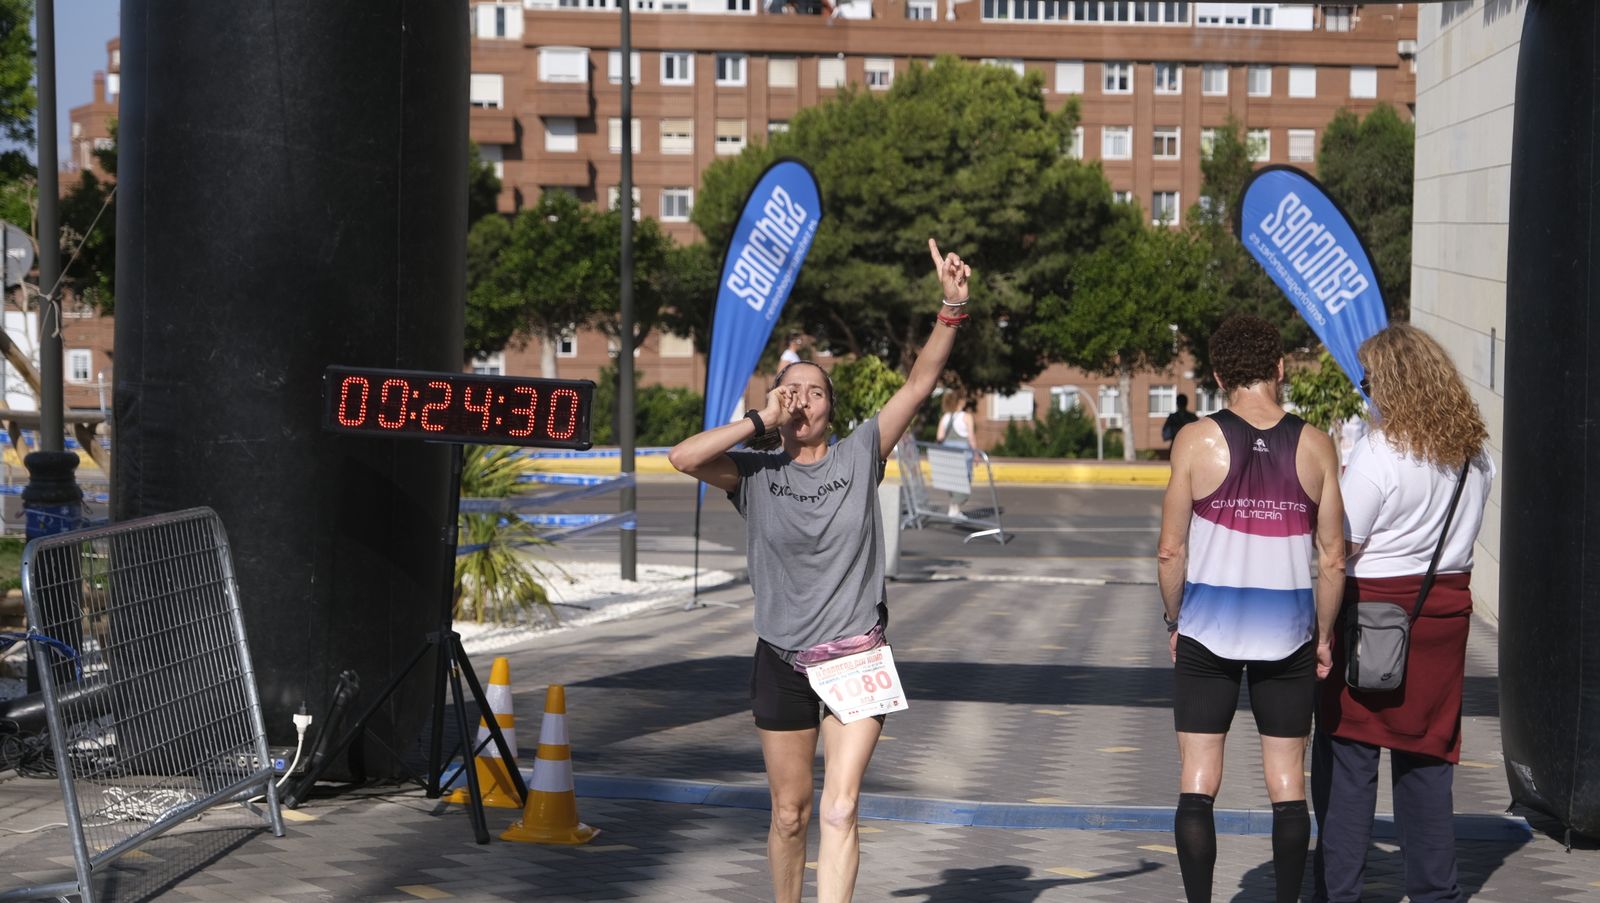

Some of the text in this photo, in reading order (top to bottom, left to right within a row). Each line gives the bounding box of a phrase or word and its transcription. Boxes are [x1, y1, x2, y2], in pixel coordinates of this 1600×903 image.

[337, 376, 579, 439] 00:24:30
[1234, 509, 1283, 520] ALMERÍA
[828, 671, 893, 702] 1080
